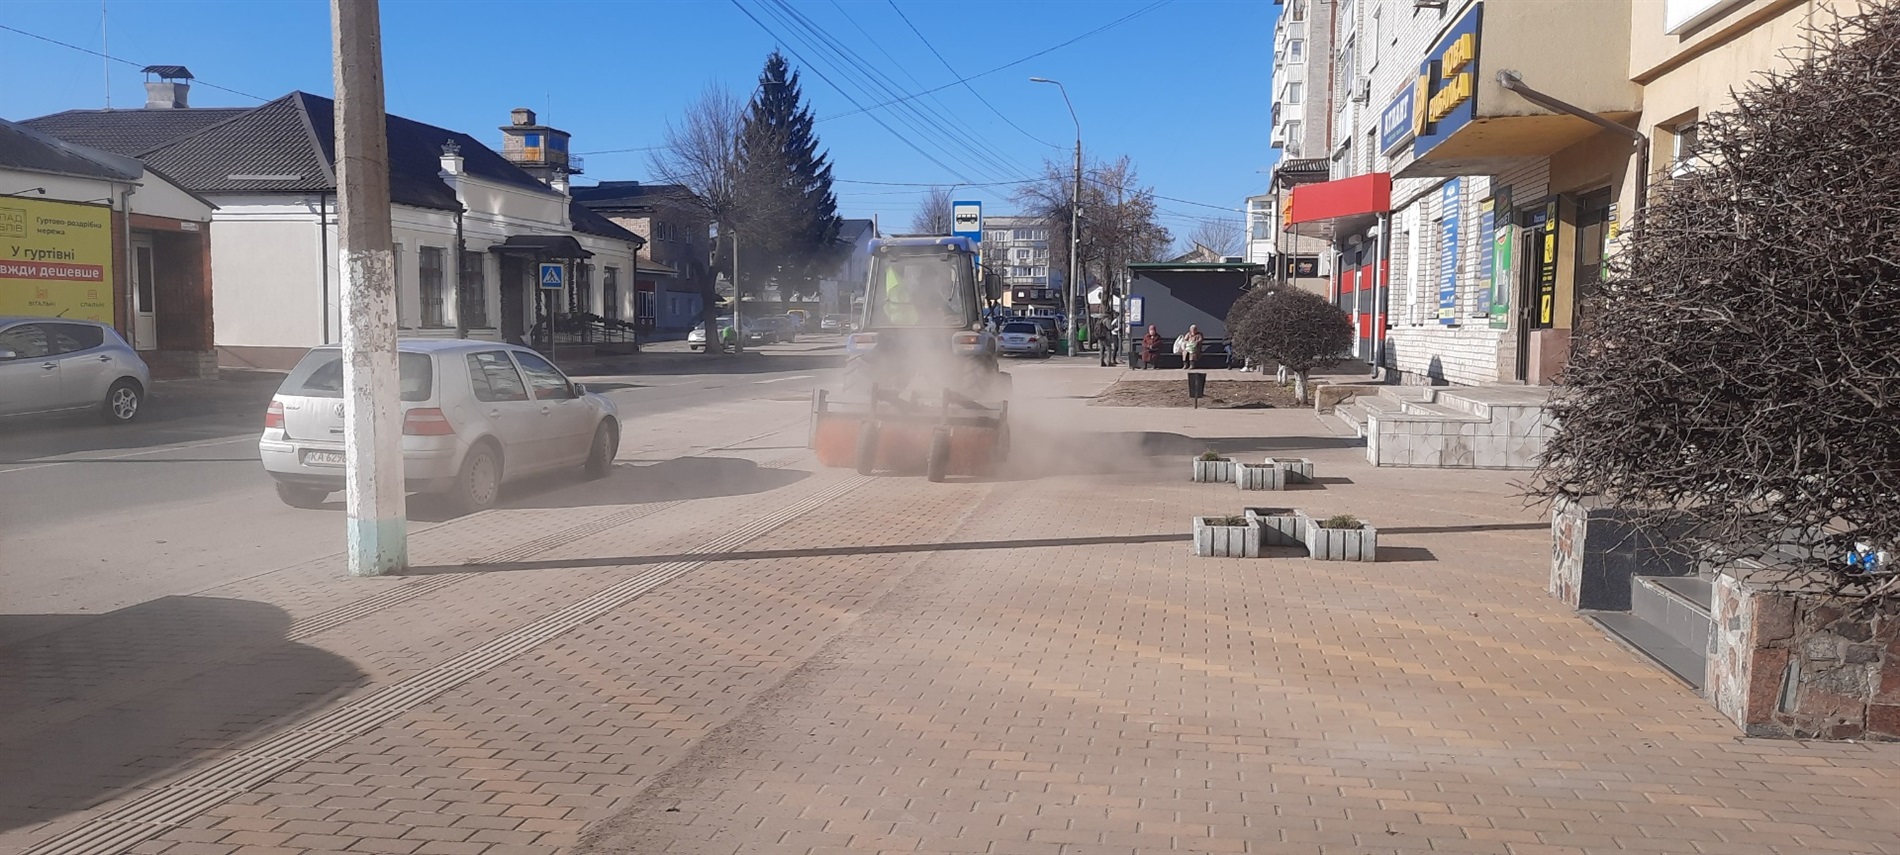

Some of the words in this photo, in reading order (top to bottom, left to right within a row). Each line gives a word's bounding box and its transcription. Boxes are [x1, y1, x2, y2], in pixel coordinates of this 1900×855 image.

[1442, 33, 1471, 79] НОВА
[11, 245, 20, 257] У
[24, 247, 75, 261] гуртівні
[40, 266, 99, 277] дешевше
[310, 452, 324, 461] KA
